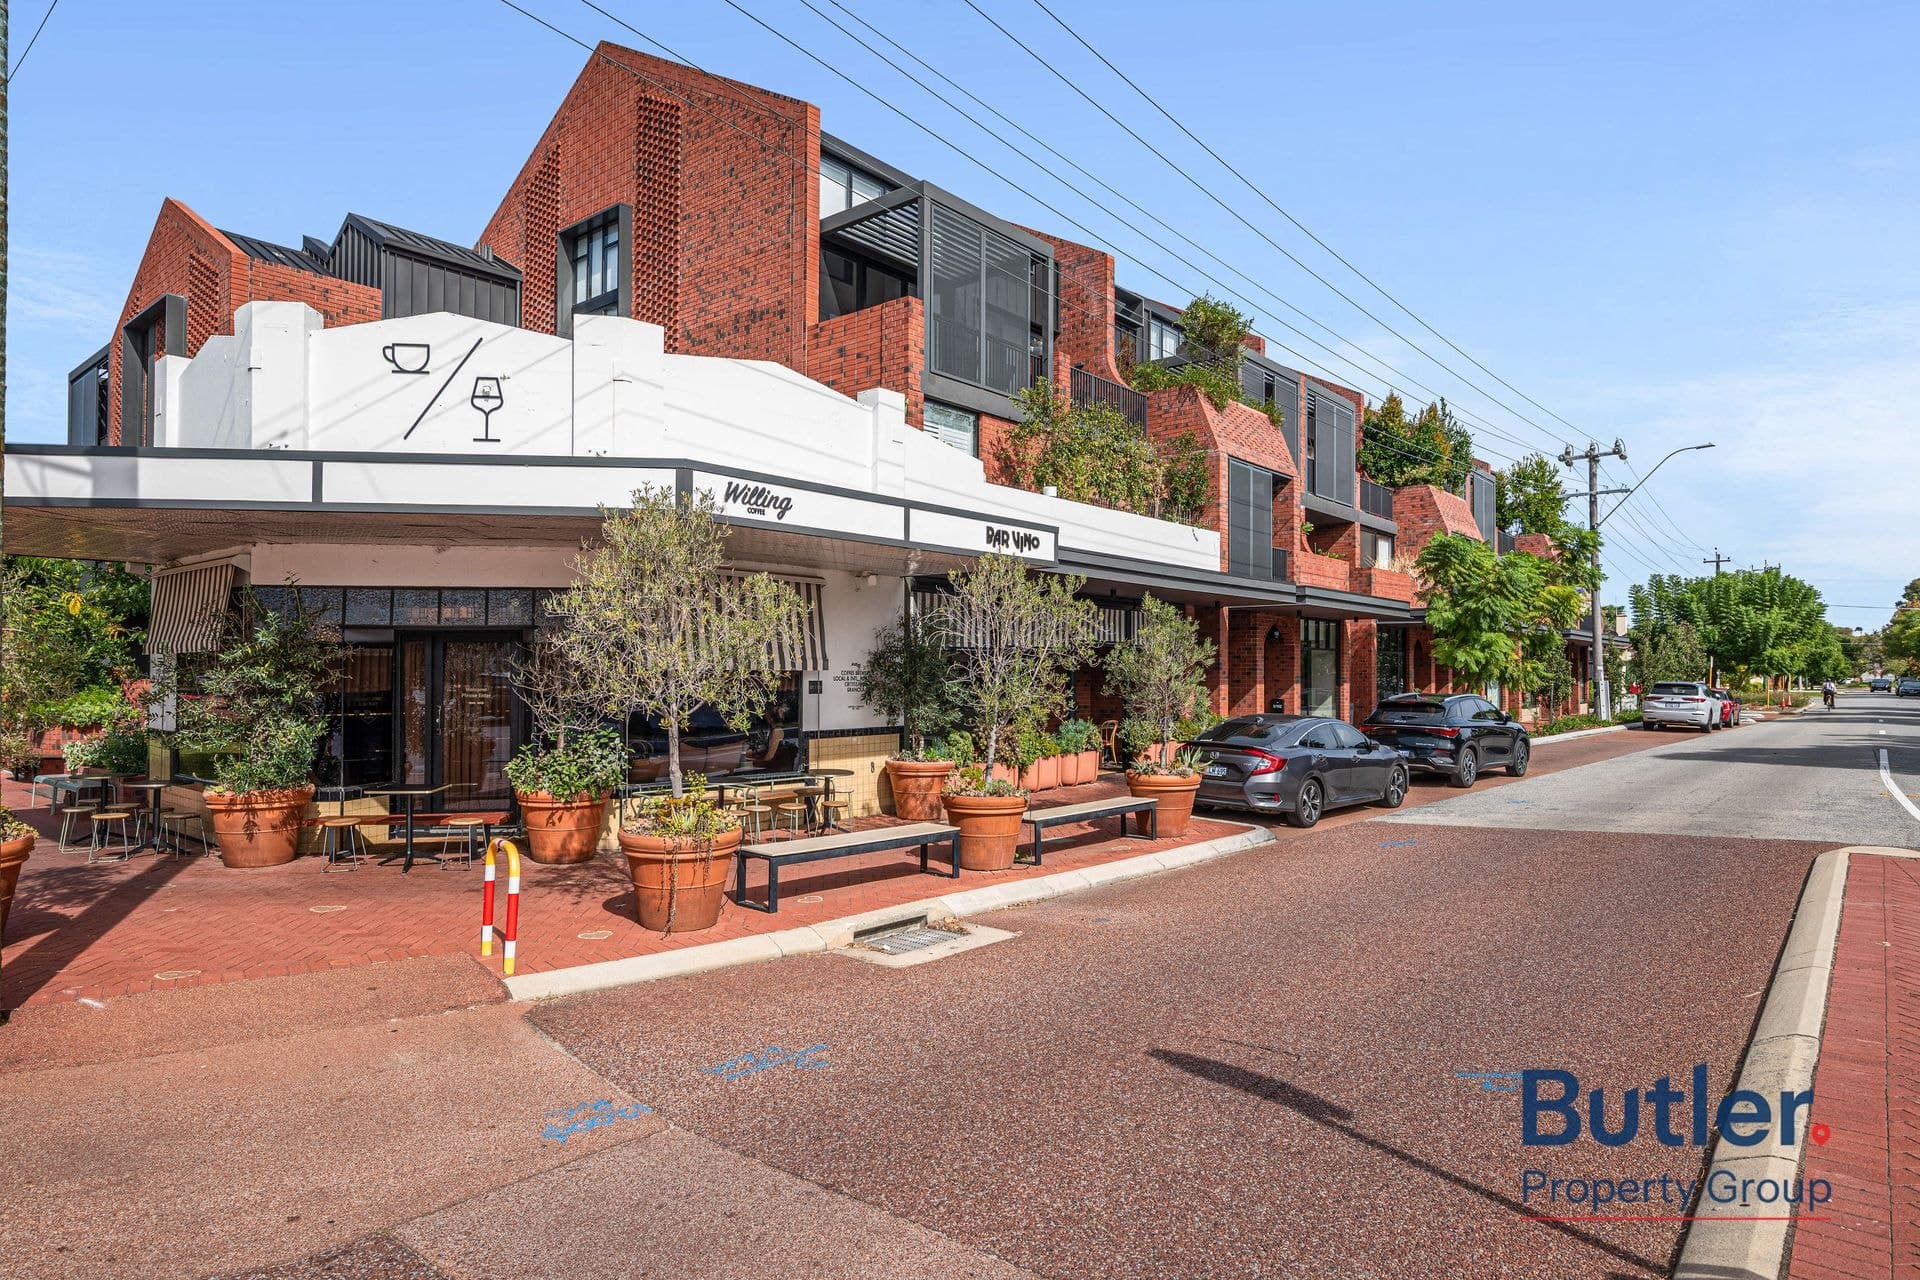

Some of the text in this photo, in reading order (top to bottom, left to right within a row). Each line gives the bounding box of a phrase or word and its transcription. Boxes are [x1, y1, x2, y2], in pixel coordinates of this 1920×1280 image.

[724, 481, 793, 520] Willing
[747, 507, 765, 516] COFFEE
[986, 526, 1040, 553] BAR VINO
